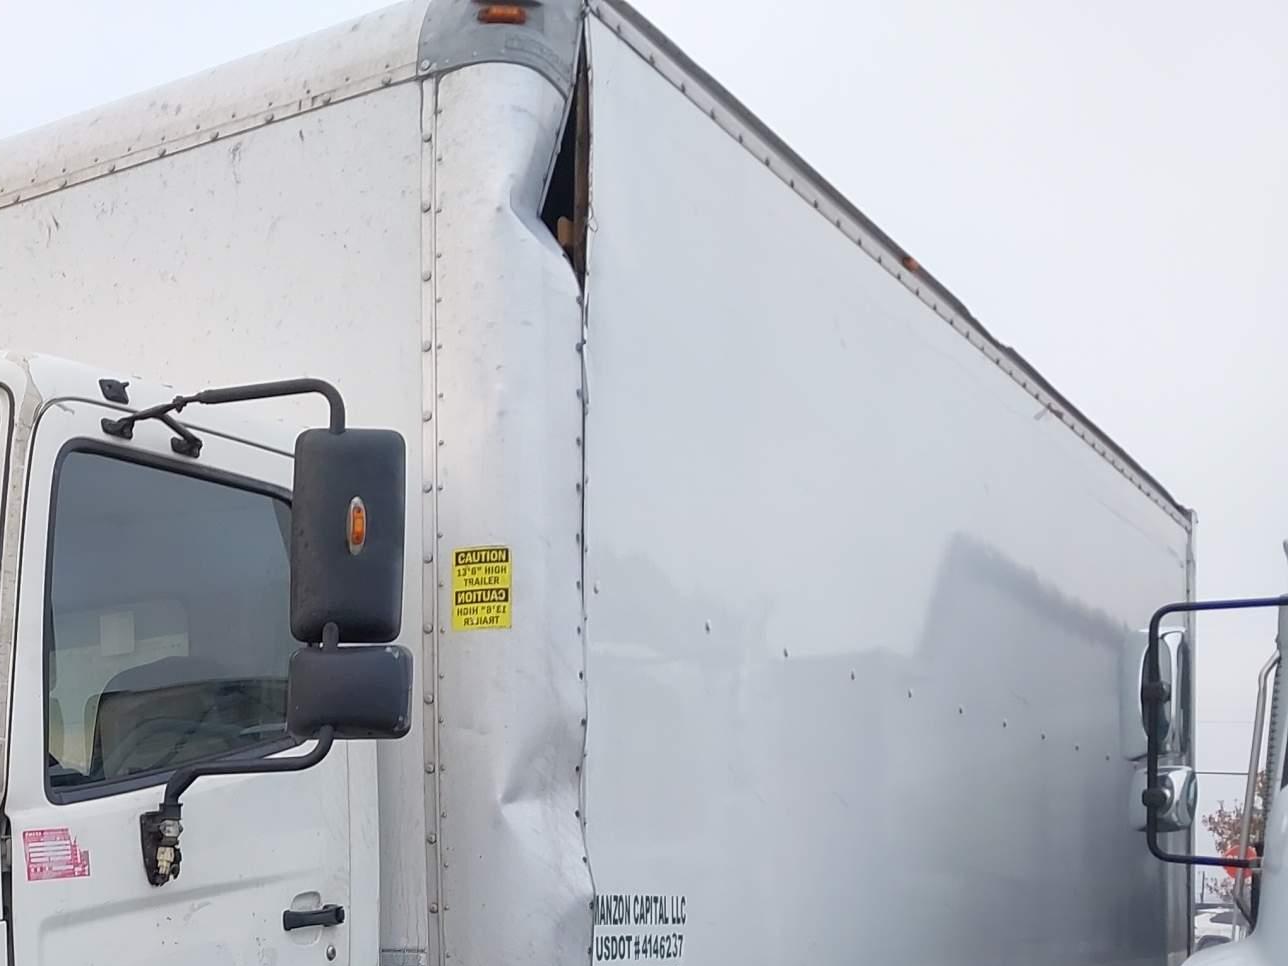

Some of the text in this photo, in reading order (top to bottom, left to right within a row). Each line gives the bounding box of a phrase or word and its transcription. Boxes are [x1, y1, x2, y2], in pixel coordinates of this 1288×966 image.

[457, 549, 507, 565] CAUTION
[484, 565, 507, 575] HIGH
[464, 576, 500, 587] TRAILER
[633, 894, 669, 926] CAPITAL
[671, 895, 687, 926] LLC
[596, 935, 633, 961] USDOT
